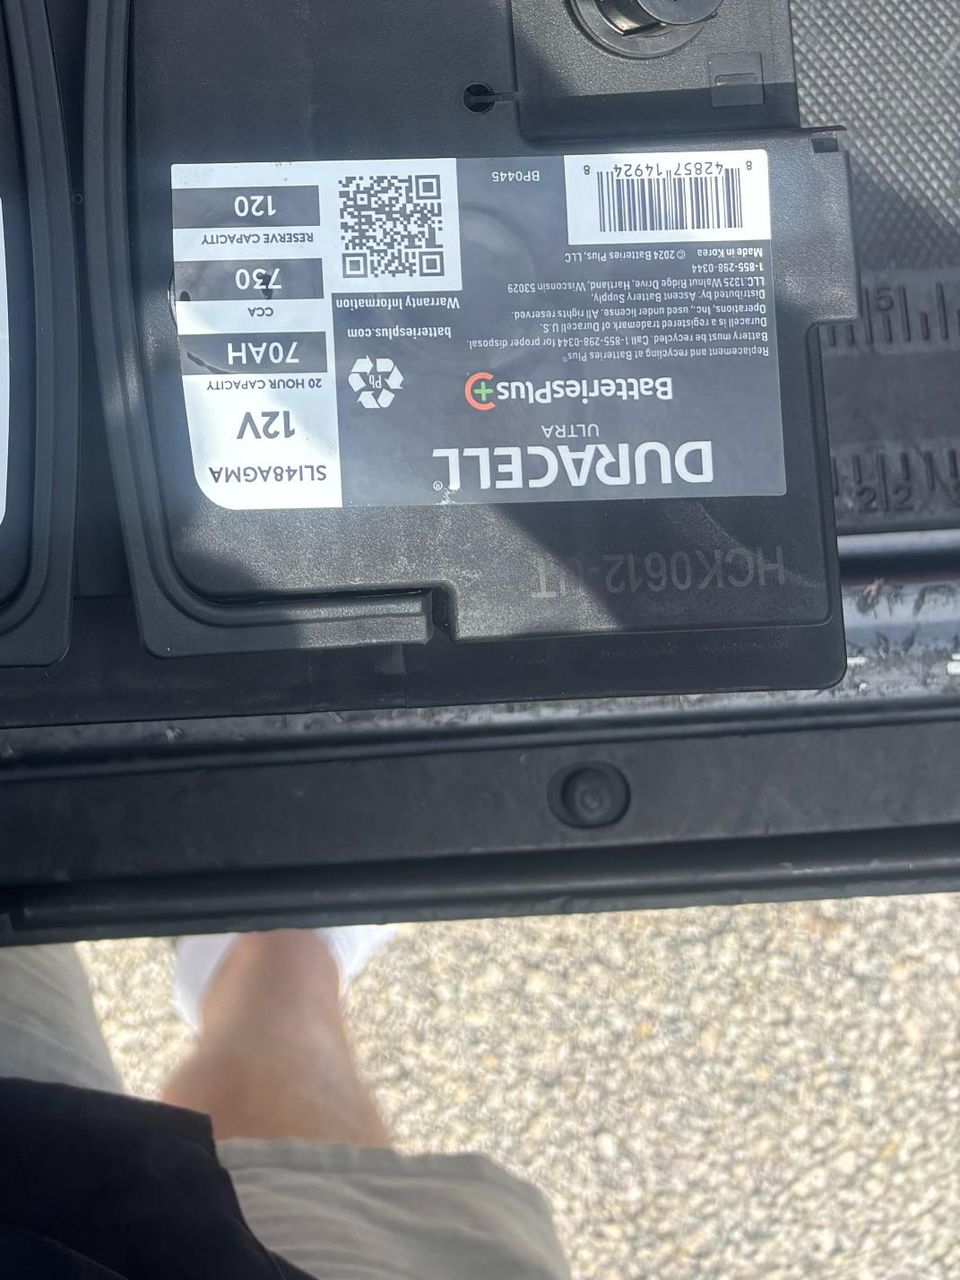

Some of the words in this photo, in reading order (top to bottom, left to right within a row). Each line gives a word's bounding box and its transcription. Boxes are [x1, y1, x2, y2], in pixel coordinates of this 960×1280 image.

[491, 169, 539, 181] BP0445
[610, 163, 662, 178] 14924
[672, 161, 726, 178] 42857
[234, 195, 276, 216] 120
[201, 233, 260, 244] CAPACITY
[262, 232, 313, 243] RESERVE
[564, 252, 582, 262] LLC
[608, 250, 651, 260] Batteries
[697, 248, 724, 258] Korea
[726, 248, 734, 257] in
[736, 247, 762, 257] Made
[691, 261, 763, 273] 1-855-298-0344
[235, 268, 282, 289] 730
[335, 297, 402, 310] Information
[405, 294, 460, 309] Warranty
[247, 306, 273, 317] CCA
[347, 324, 451, 339] batteriesplus.com
[227, 341, 299, 365] 70AH
[206, 379, 265, 390] CAPACITY
[268, 378, 304, 389] HOUR
[307, 377, 322, 388] 20
[236, 410, 295, 439] 12V
[540, 423, 599, 438] ULTRA
[433, 441, 713, 489] DURACELL
